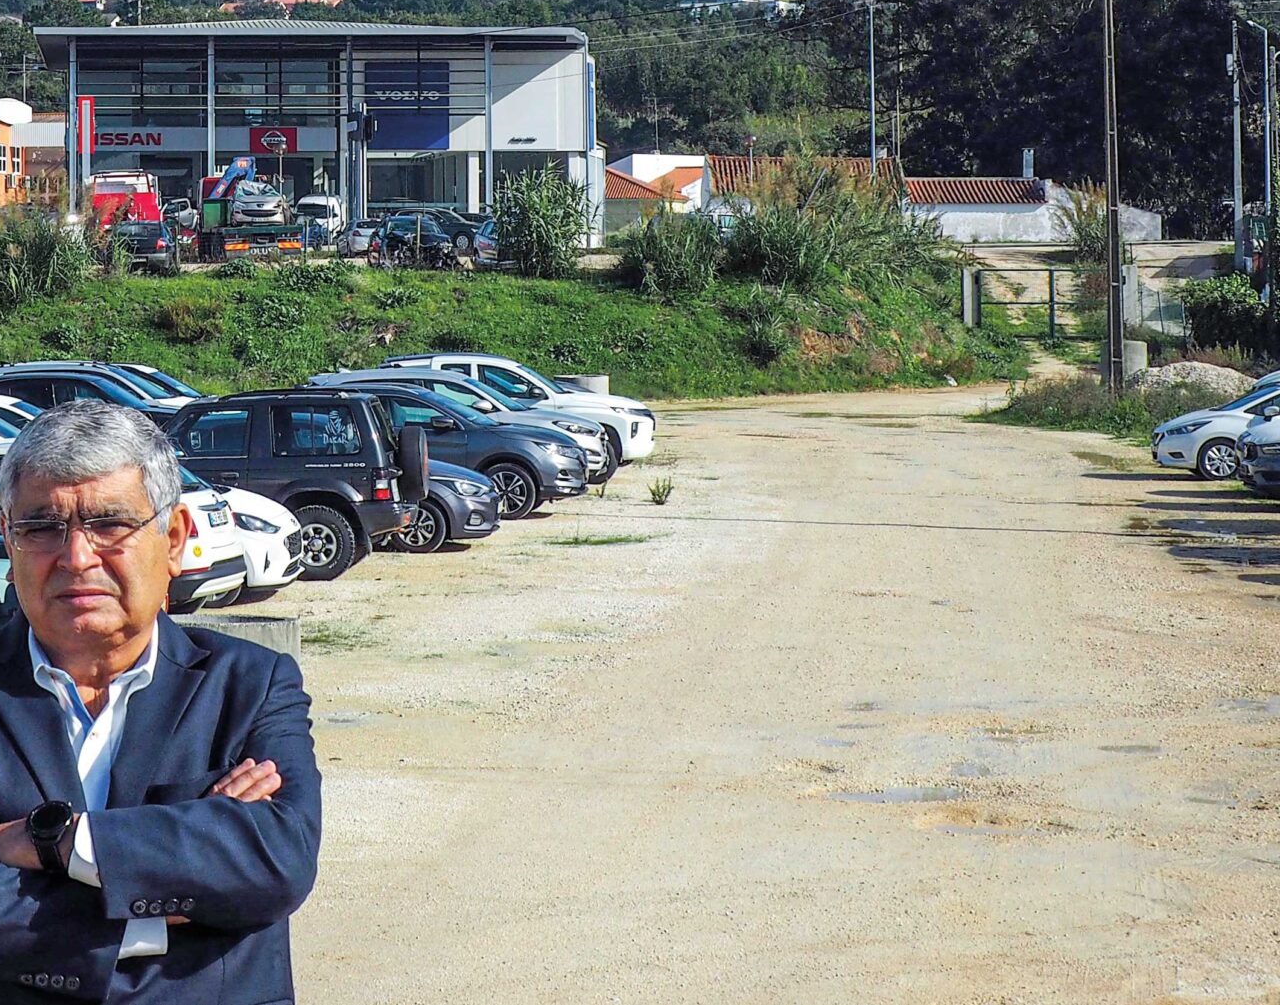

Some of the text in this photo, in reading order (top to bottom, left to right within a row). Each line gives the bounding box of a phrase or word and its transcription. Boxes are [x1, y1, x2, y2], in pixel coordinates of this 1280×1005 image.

[375, 90, 440, 101] VOLVO
[94, 132, 162, 146] ISSAN
[323, 433, 349, 445] DAKAR
